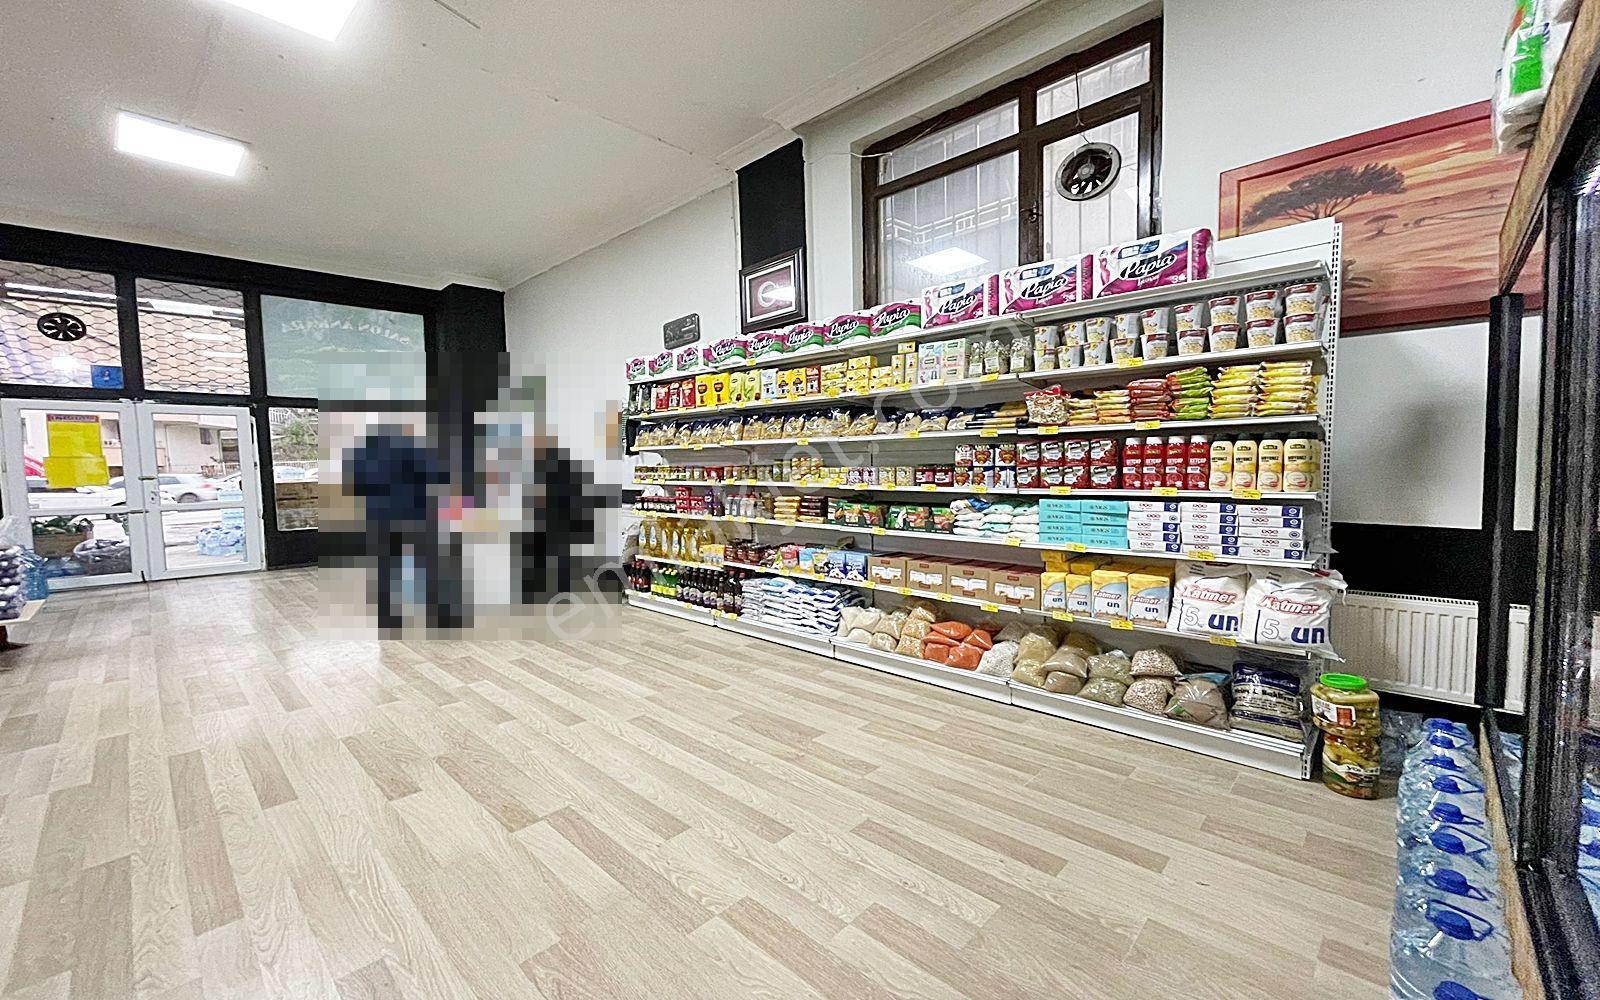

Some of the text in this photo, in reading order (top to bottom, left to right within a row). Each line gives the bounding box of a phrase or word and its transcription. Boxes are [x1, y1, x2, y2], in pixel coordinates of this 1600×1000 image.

[1121, 254, 1176, 279] Papia
[1023, 277, 1067, 298] Papia
[940, 296, 976, 314] Papia
[873, 307, 910, 327] Papia
[829, 319, 859, 337] Papia
[1182, 586, 1237, 605] Katmer
[1259, 596, 1320, 615] Katmer
[1184, 607, 1239, 631] 5 un
[1262, 619, 1325, 644] 5 un
